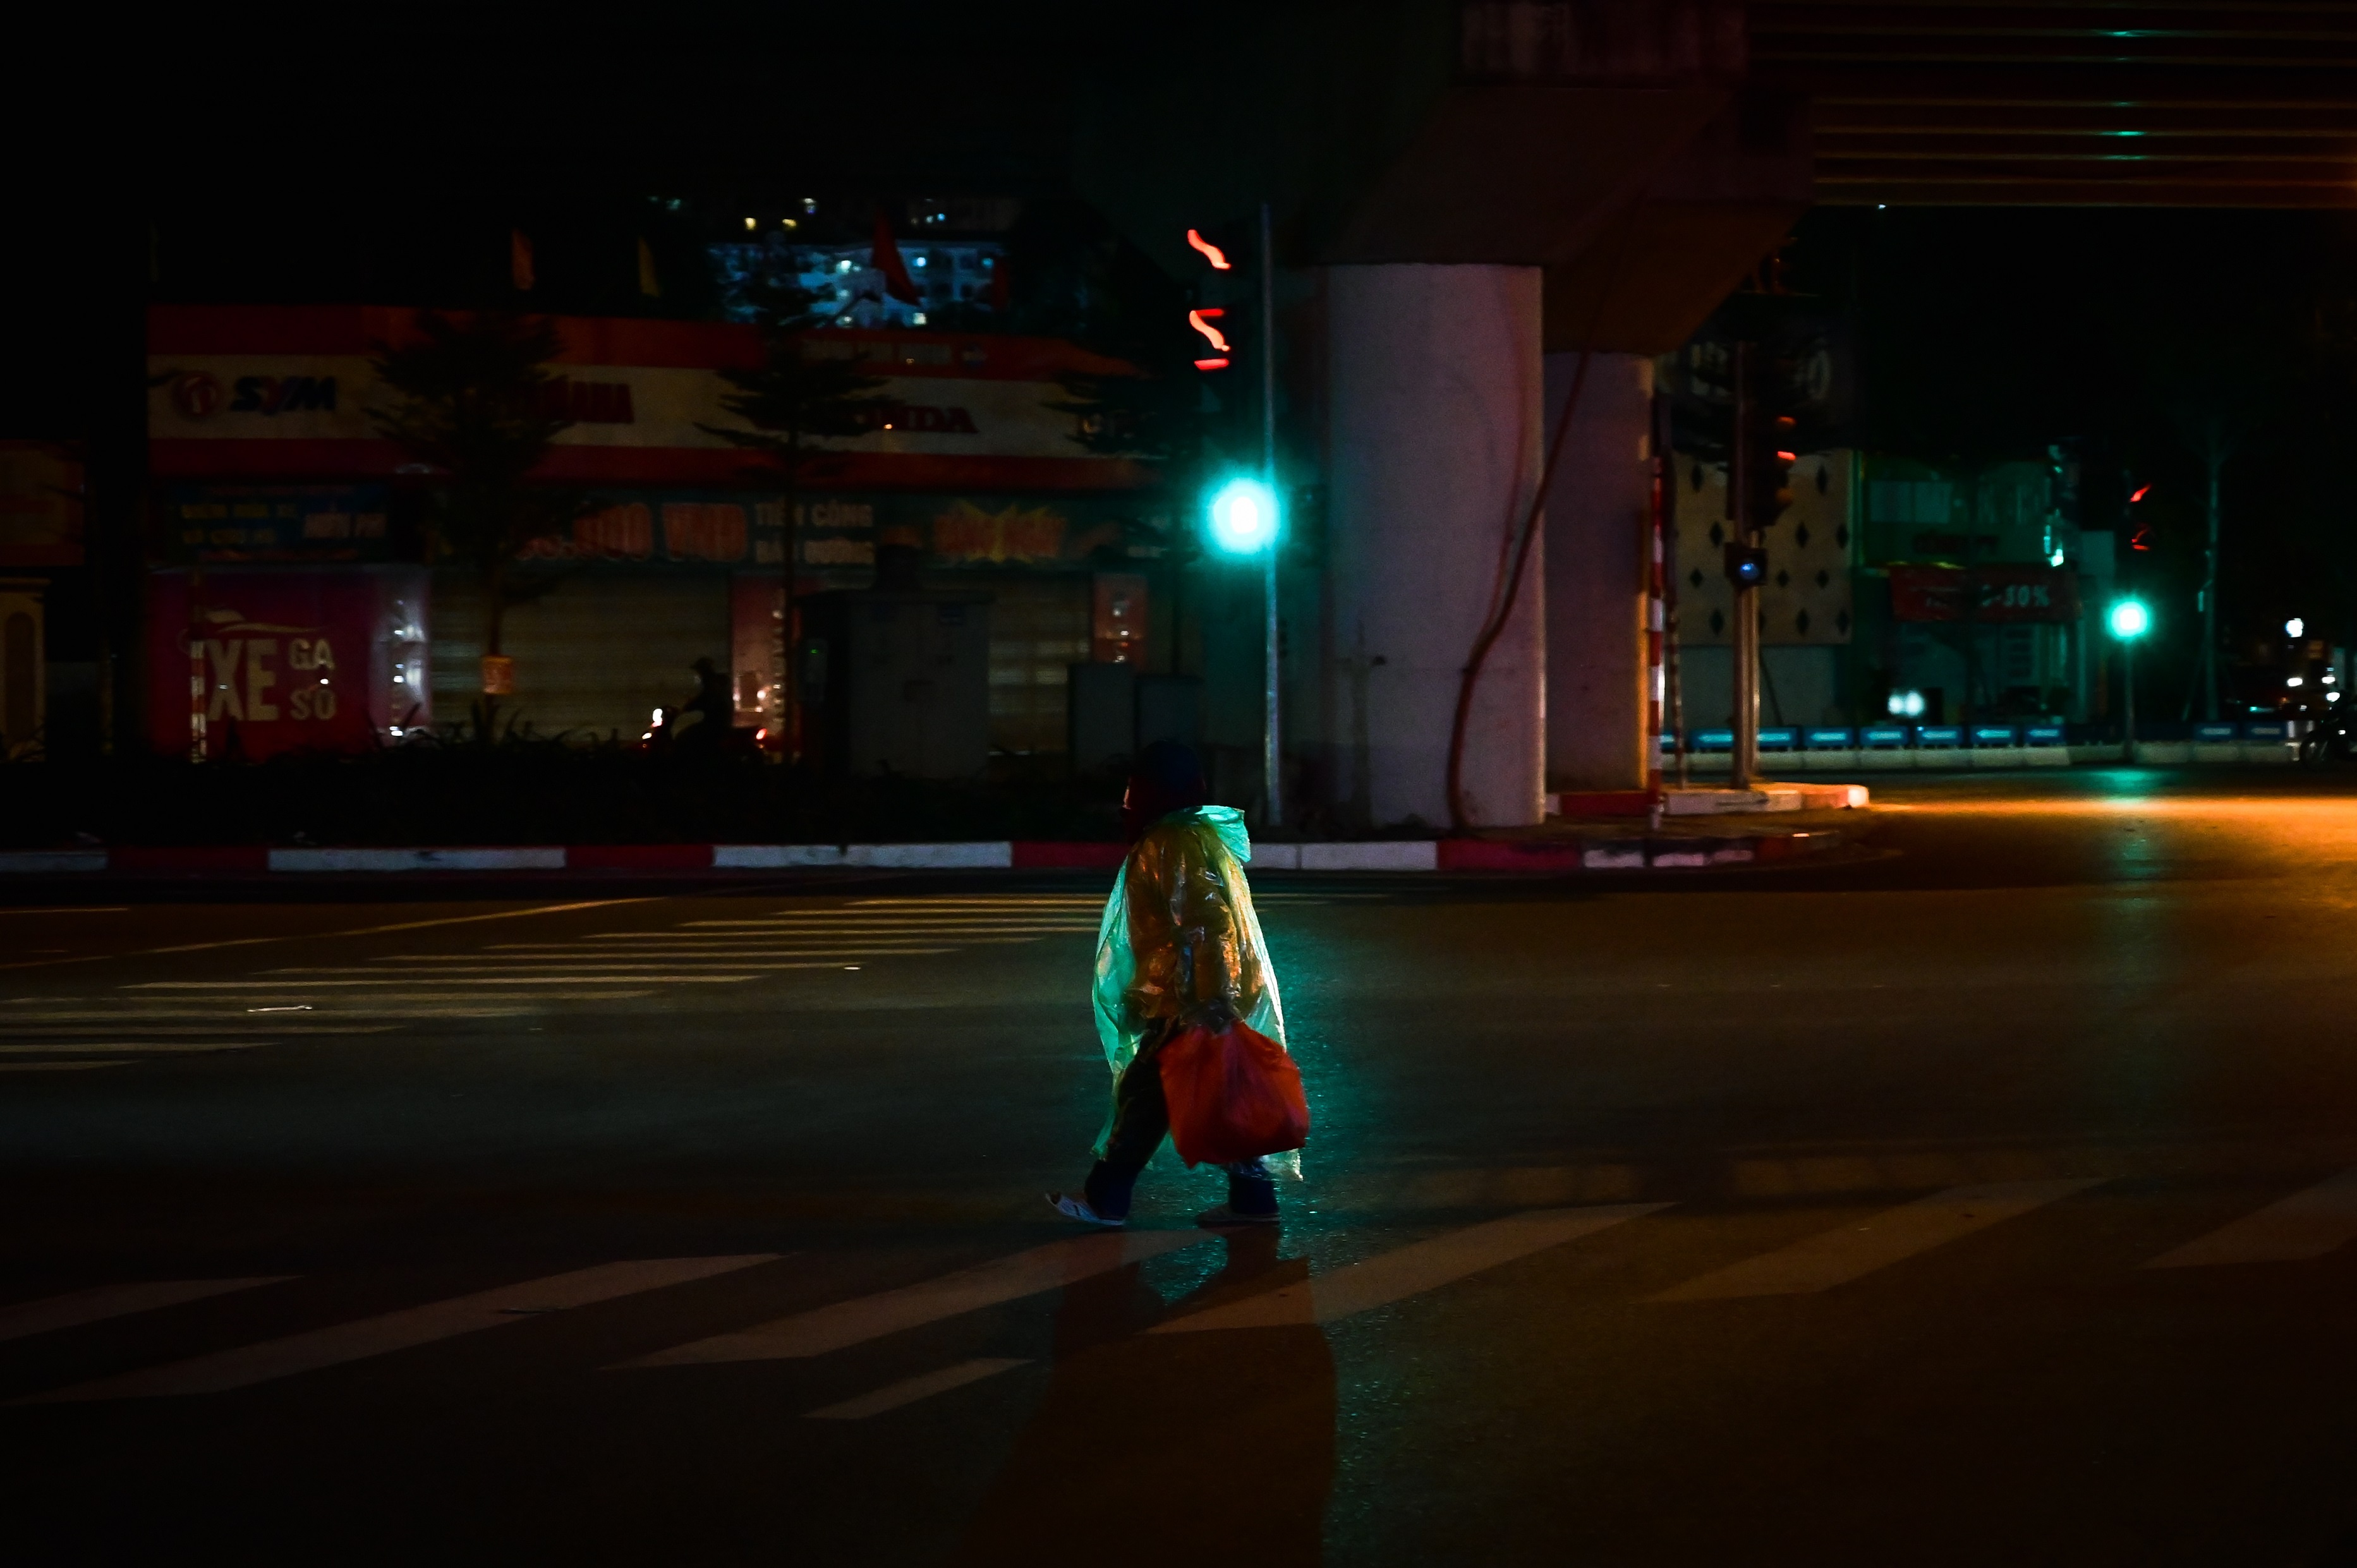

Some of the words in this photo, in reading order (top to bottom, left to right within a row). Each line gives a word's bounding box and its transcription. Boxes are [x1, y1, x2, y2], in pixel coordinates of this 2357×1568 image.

[231, 377, 336, 414] SYM
[288, 637, 335, 671] GA
[204, 637, 279, 721] XE
